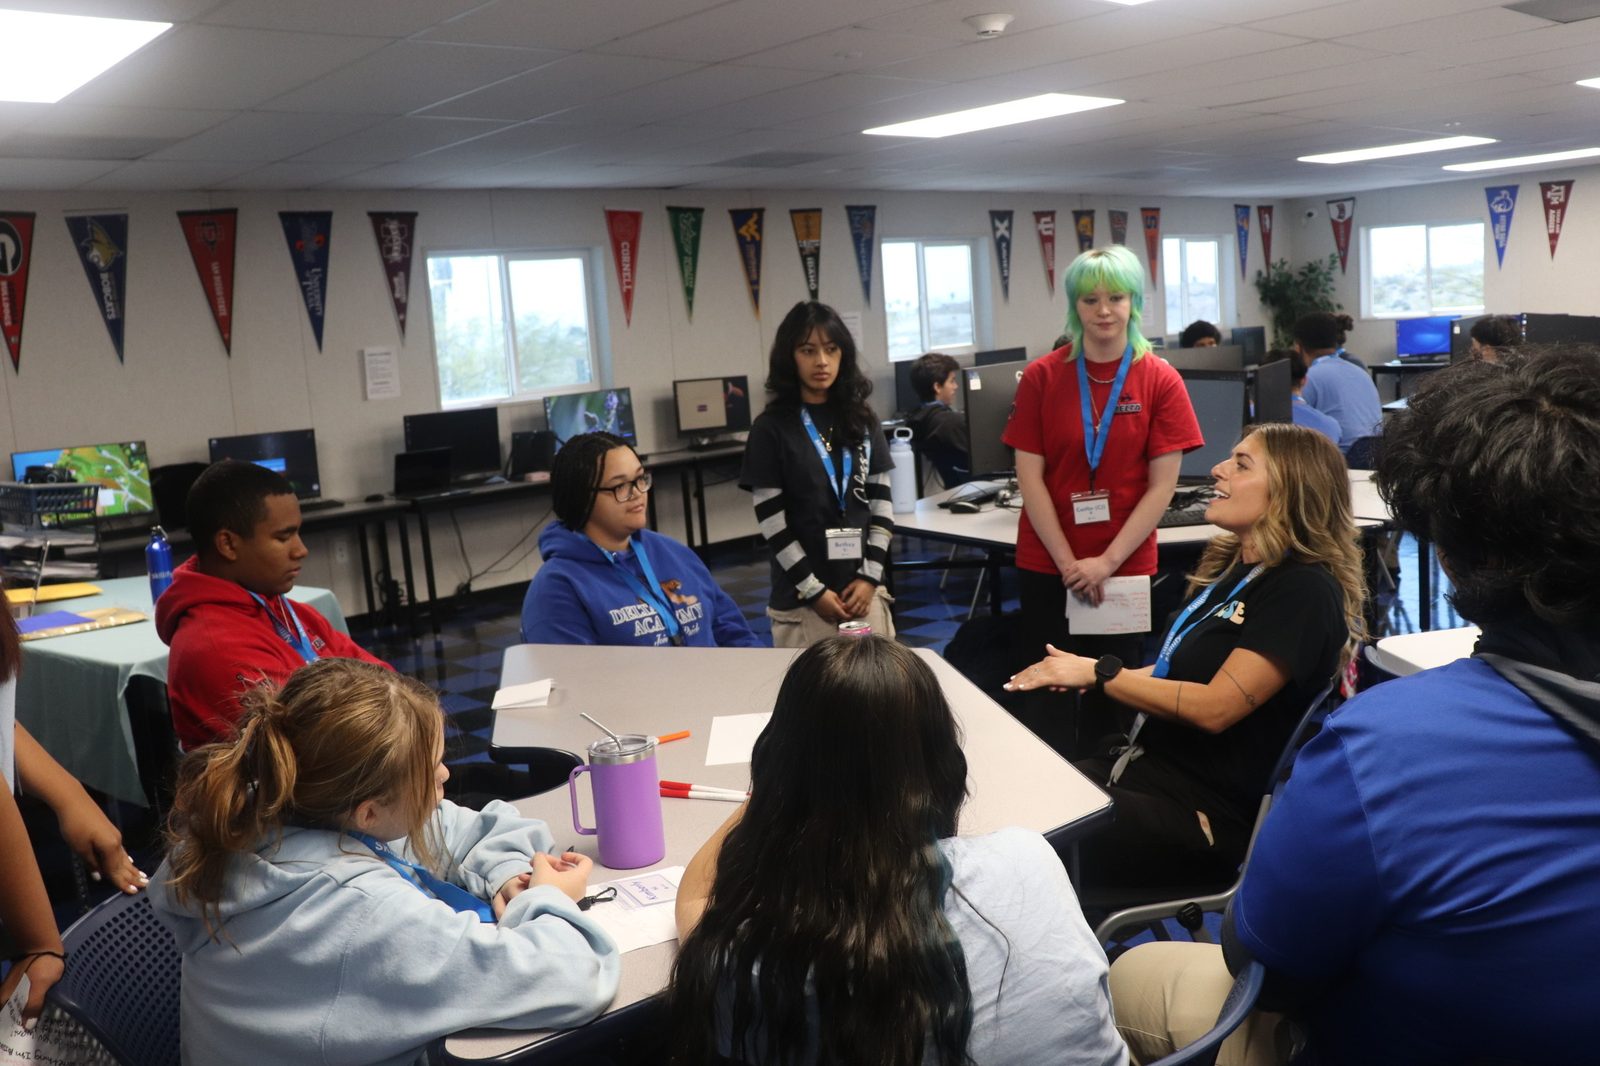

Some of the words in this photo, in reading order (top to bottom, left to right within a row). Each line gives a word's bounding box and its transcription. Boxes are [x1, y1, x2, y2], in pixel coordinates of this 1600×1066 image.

[620, 242, 634, 292] CORNELL
[806, 257, 817, 290] IDAHO
[1001, 241, 1009, 277] XAVIER
[0, 281, 13, 326] BULLDOGS
[100, 272, 117, 320] BOBCATS
[634, 602, 704, 637] ACAMY
